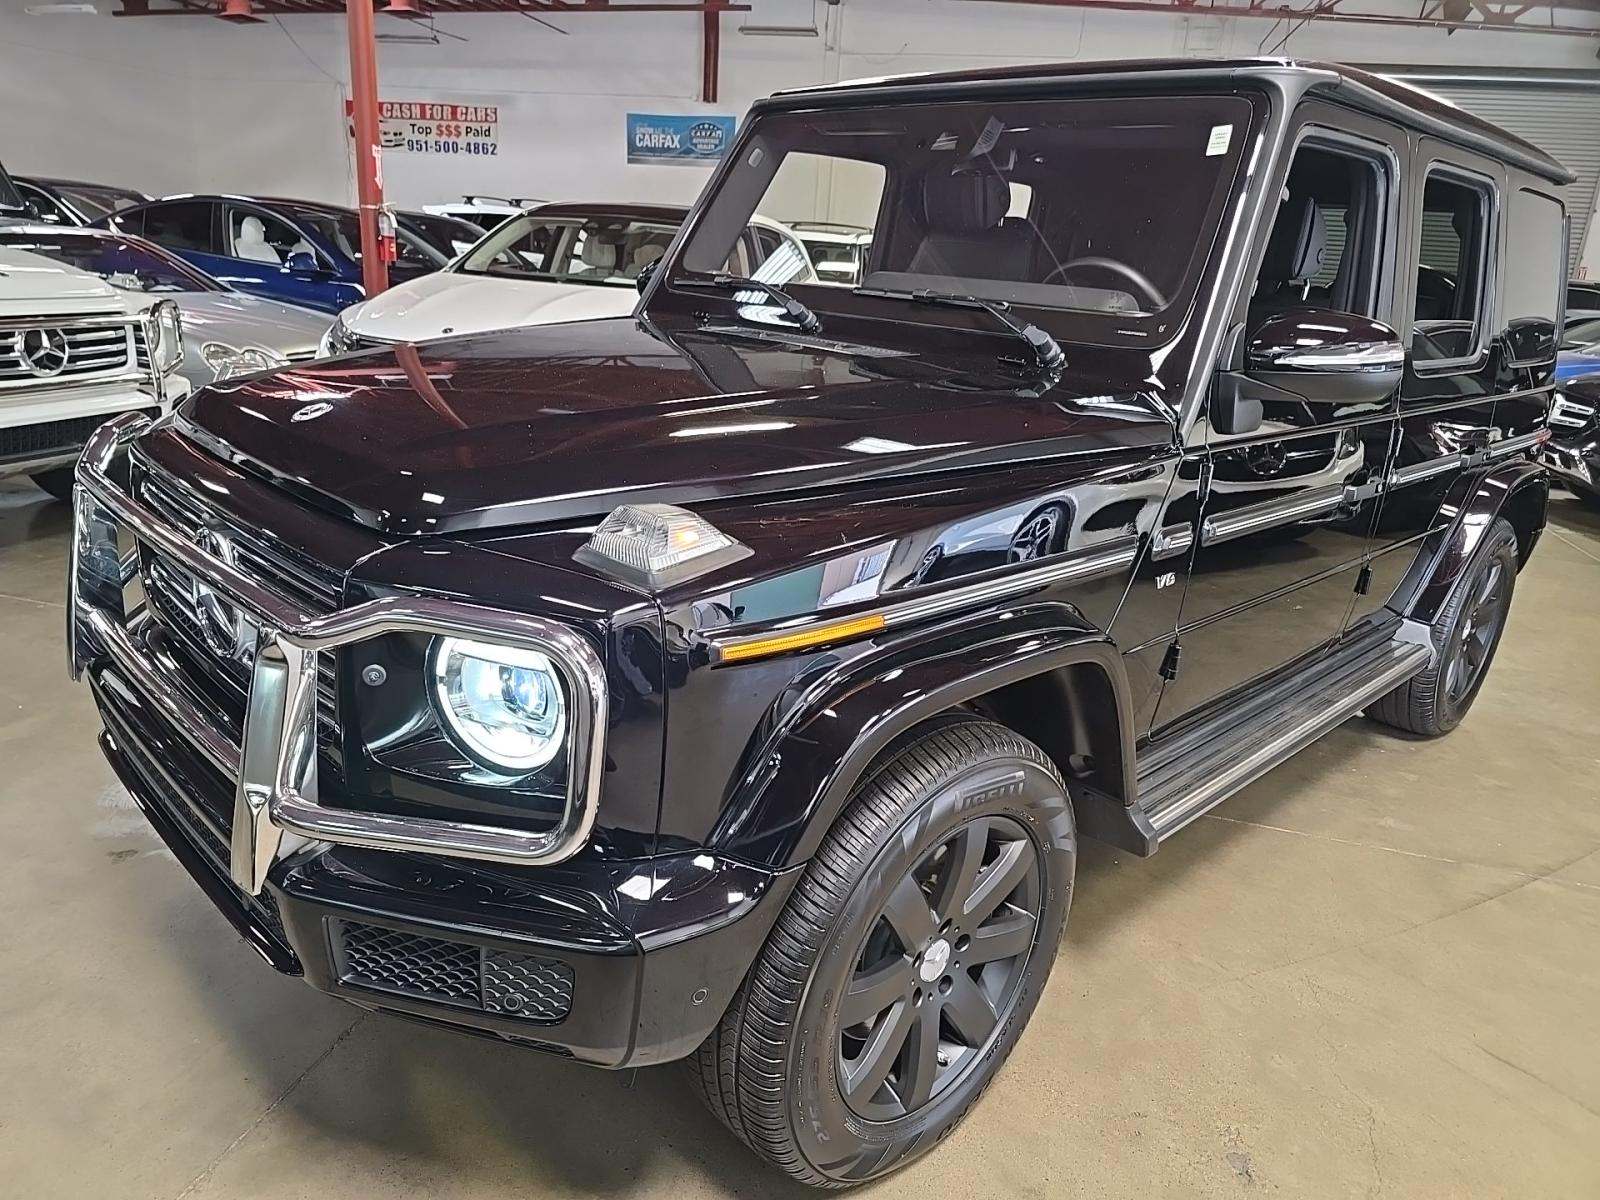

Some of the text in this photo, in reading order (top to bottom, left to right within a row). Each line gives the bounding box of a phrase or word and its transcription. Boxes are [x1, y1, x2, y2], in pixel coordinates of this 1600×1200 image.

[383, 103, 496, 122] CASH FOR CARS
[409, 123, 491, 138] Top $$$ Paid
[407, 139, 498, 155] 951-500-4862
[635, 133, 680, 149] CARFAX
[1155, 572, 1176, 590] V6
